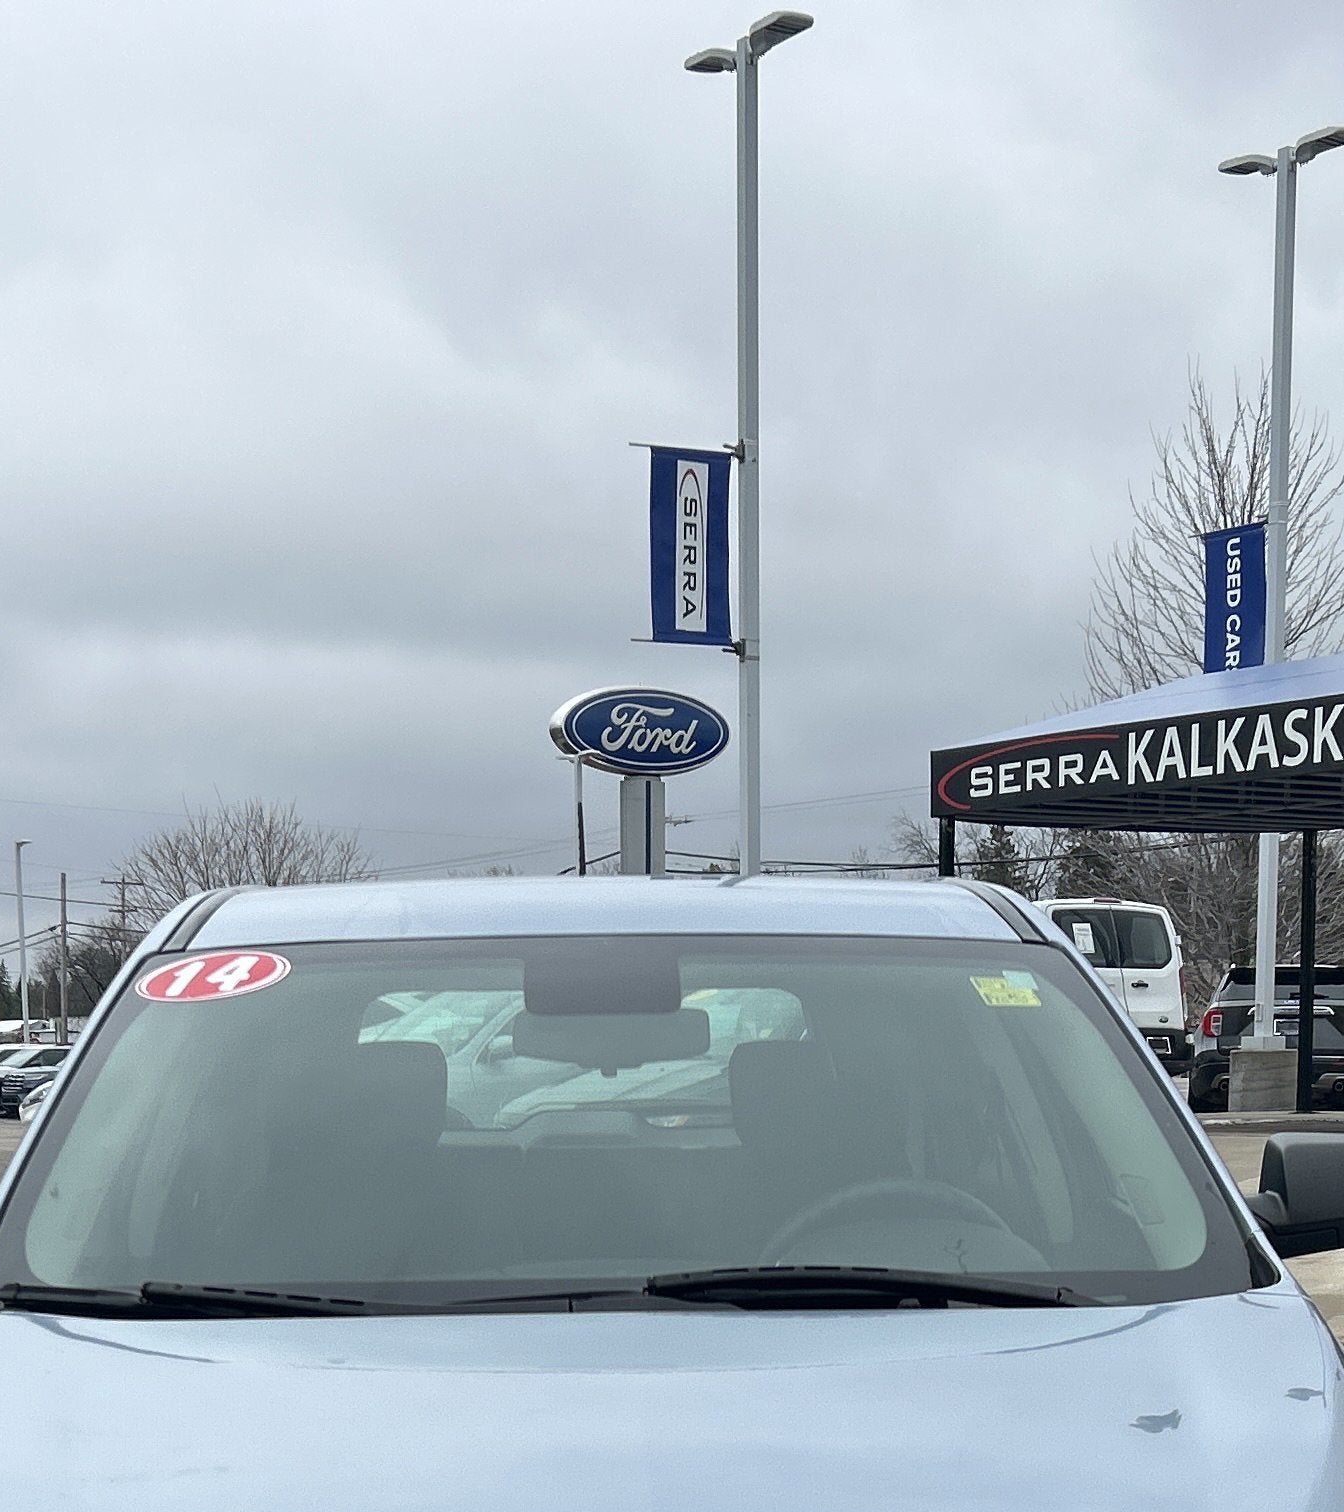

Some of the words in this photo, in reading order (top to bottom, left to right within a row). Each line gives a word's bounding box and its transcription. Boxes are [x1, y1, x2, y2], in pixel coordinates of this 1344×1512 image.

[682, 497, 697, 618] SERRA
[1226, 537, 1241, 608] USED
[1225, 614, 1241, 671] CAR
[600, 702, 699, 756] Ford
[968, 749, 1121, 798] SERRA
[164, 955, 260, 997] 14
